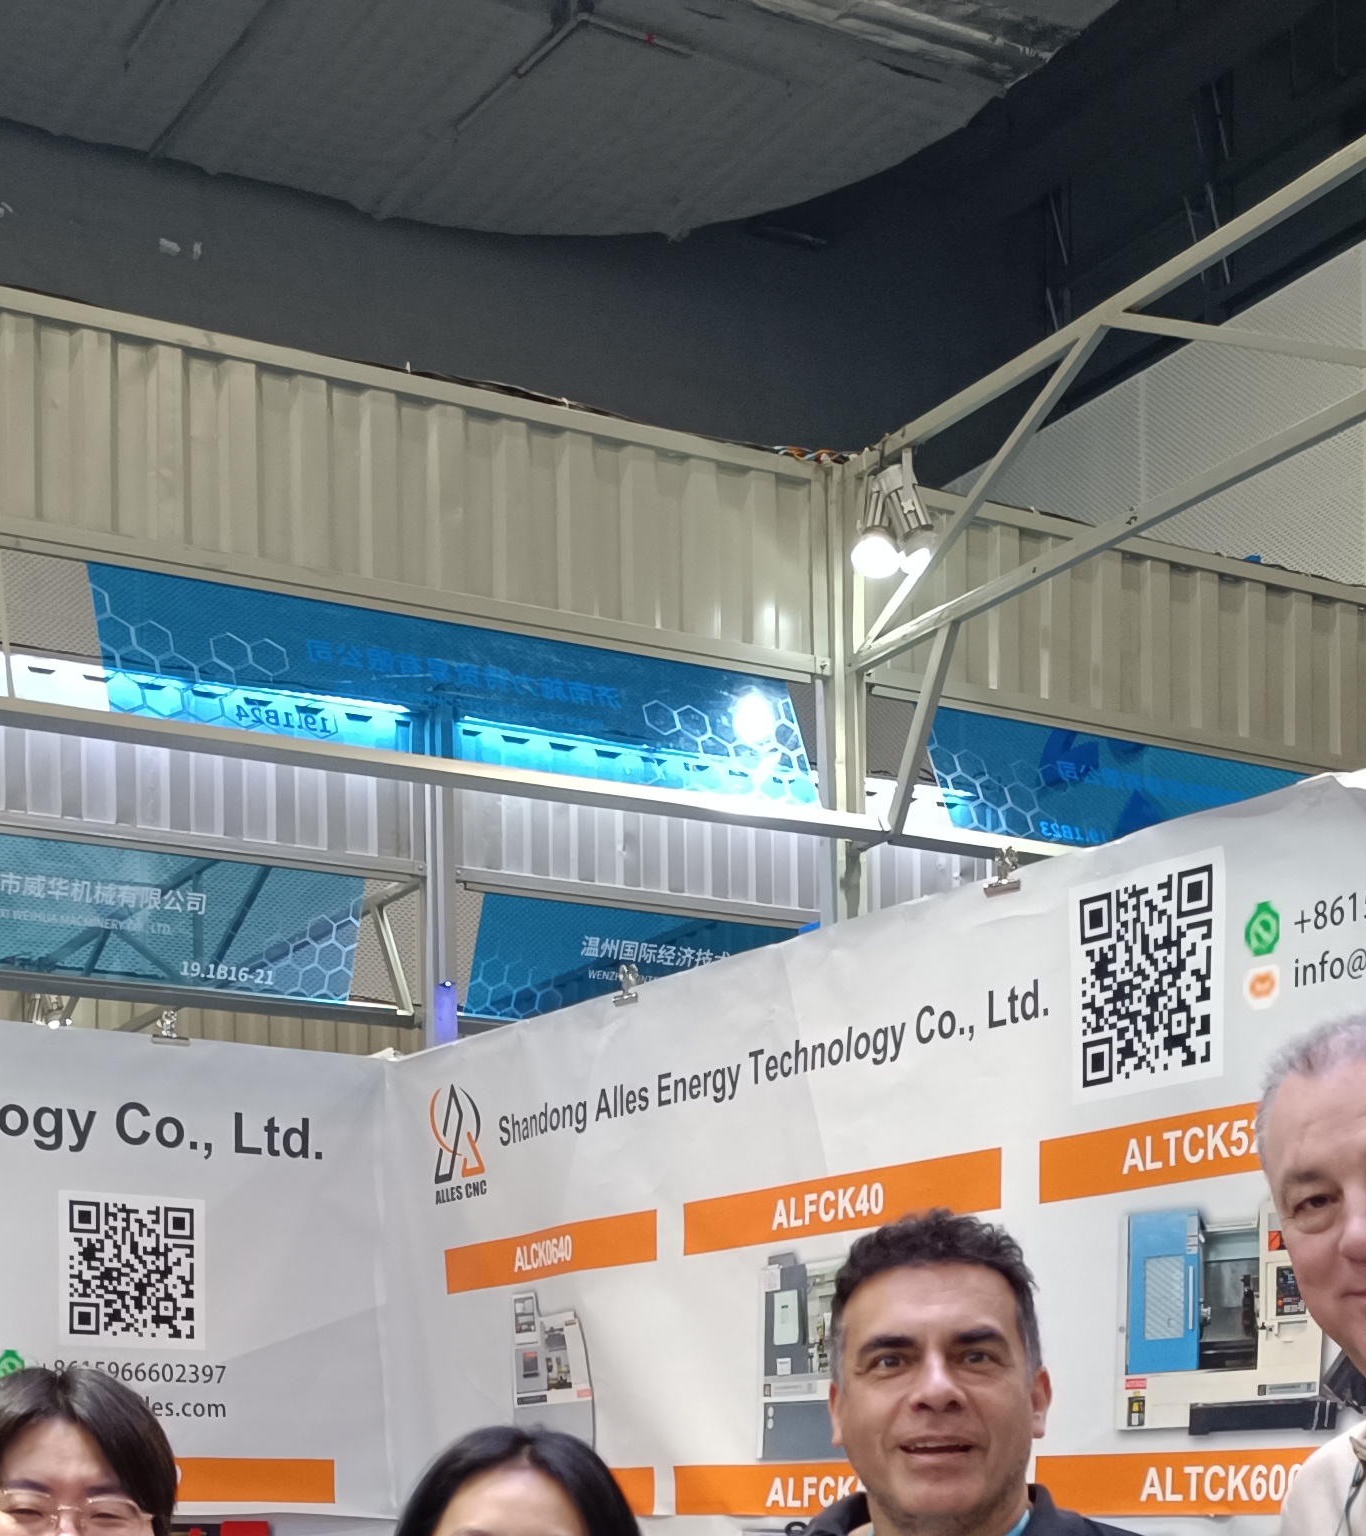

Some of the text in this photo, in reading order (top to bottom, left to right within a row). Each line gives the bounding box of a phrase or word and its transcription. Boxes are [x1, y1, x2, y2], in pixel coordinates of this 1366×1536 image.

[179, 960, 275, 986] 19.1B16-21
[498, 979, 1050, 1147] Shandong Alles Energy Technology Co., Ltd.
[115, 1101, 214, 1160] Co.,
[233, 1110, 325, 1162] Ltd.
[435, 1179, 488, 1205] ALLES CNC
[772, 1183, 885, 1231] ALFCK40
[514, 1238, 572, 1273] ALCK0640
[766, 1475, 867, 1508] ALFCK
